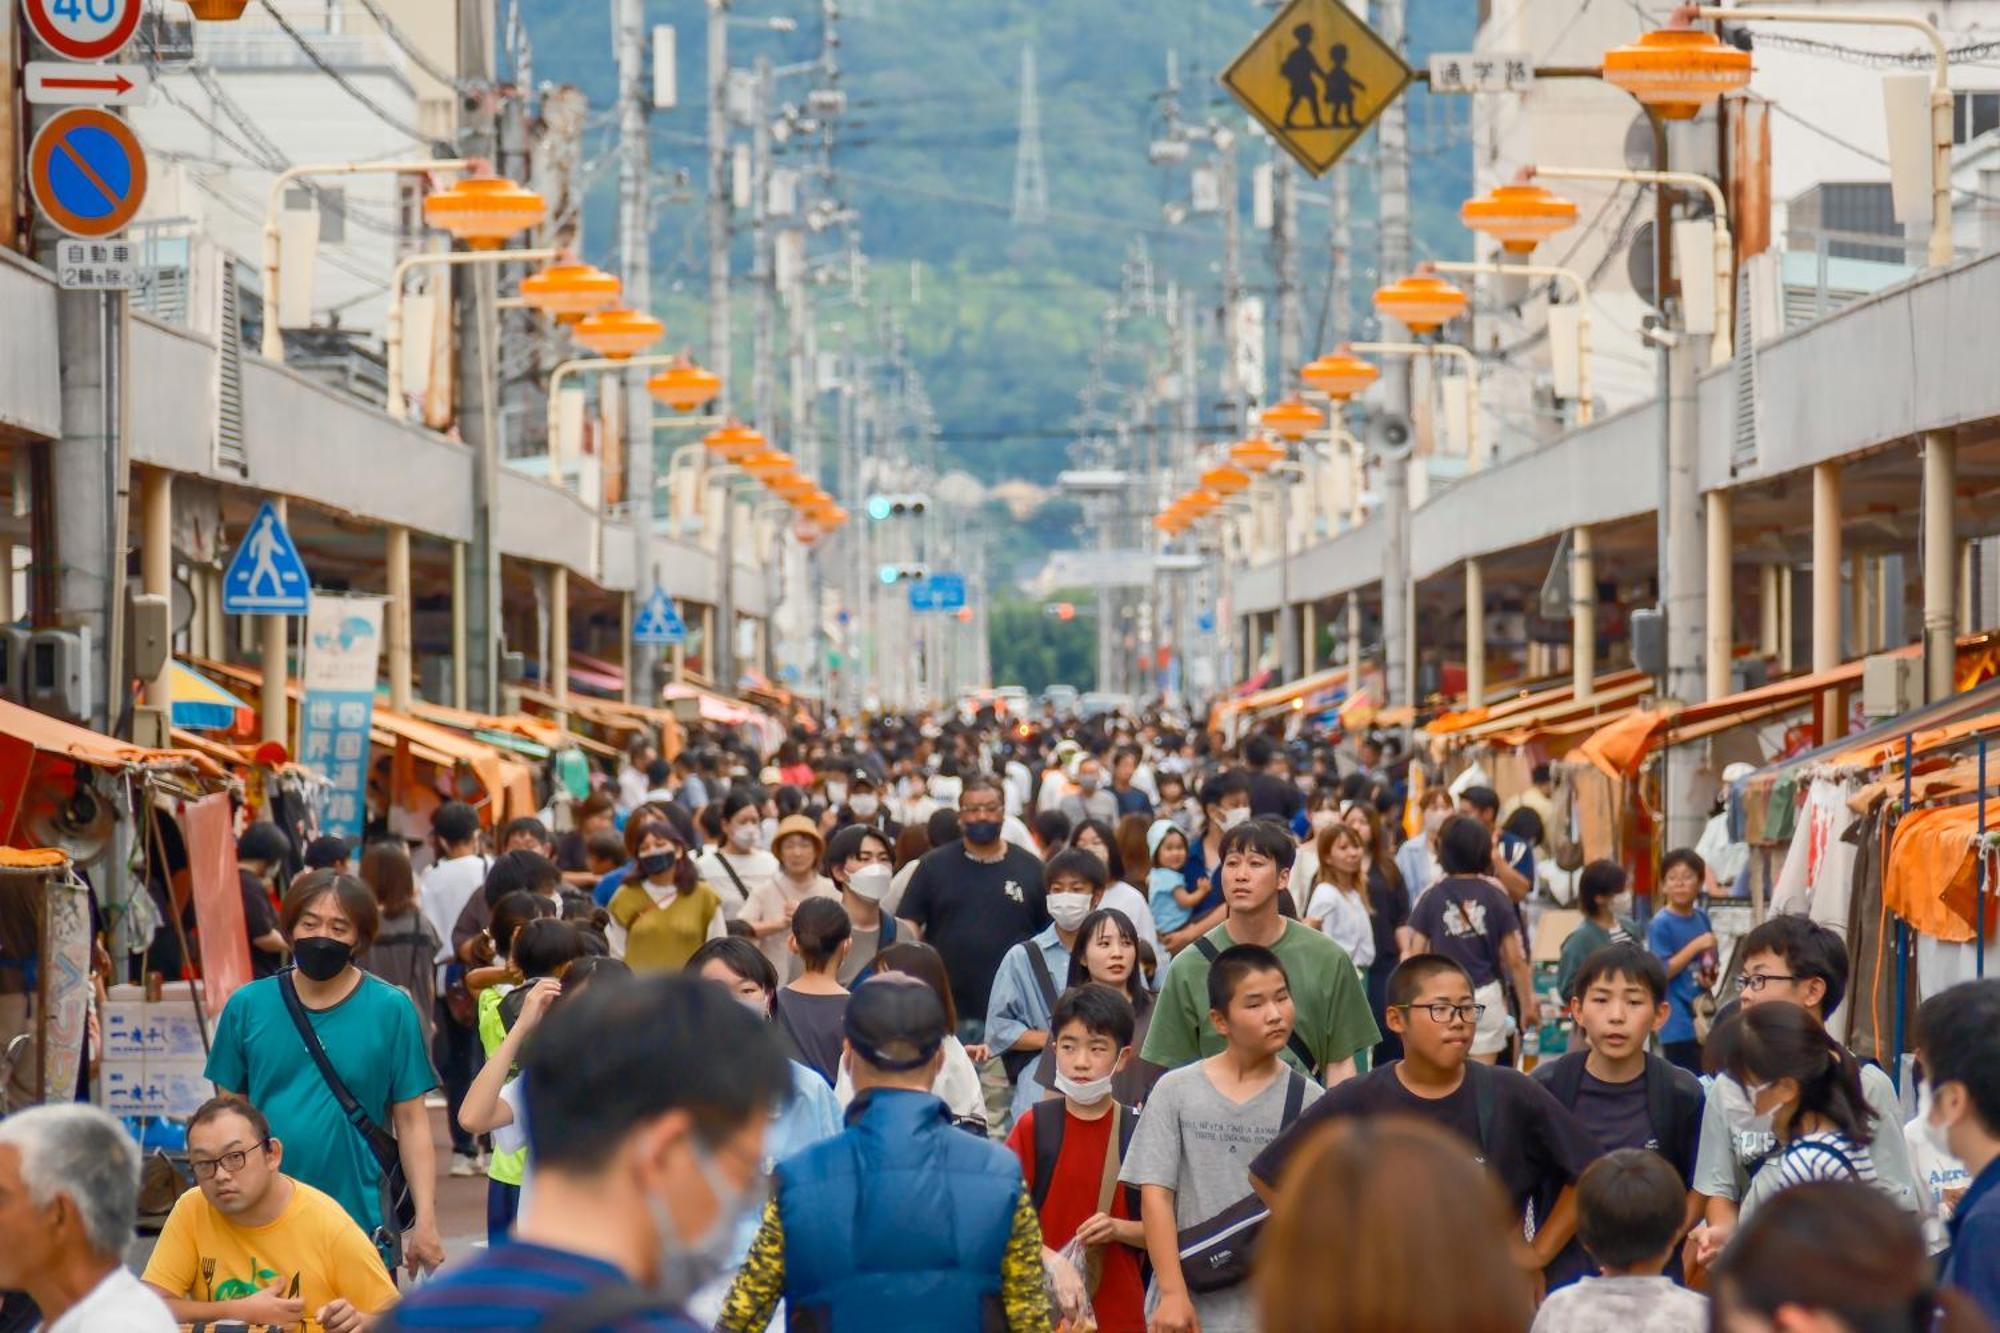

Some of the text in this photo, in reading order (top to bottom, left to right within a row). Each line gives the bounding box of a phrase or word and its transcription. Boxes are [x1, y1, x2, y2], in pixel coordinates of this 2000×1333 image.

[53, 0, 116, 23] 40
[67, 245, 129, 264] 自動車
